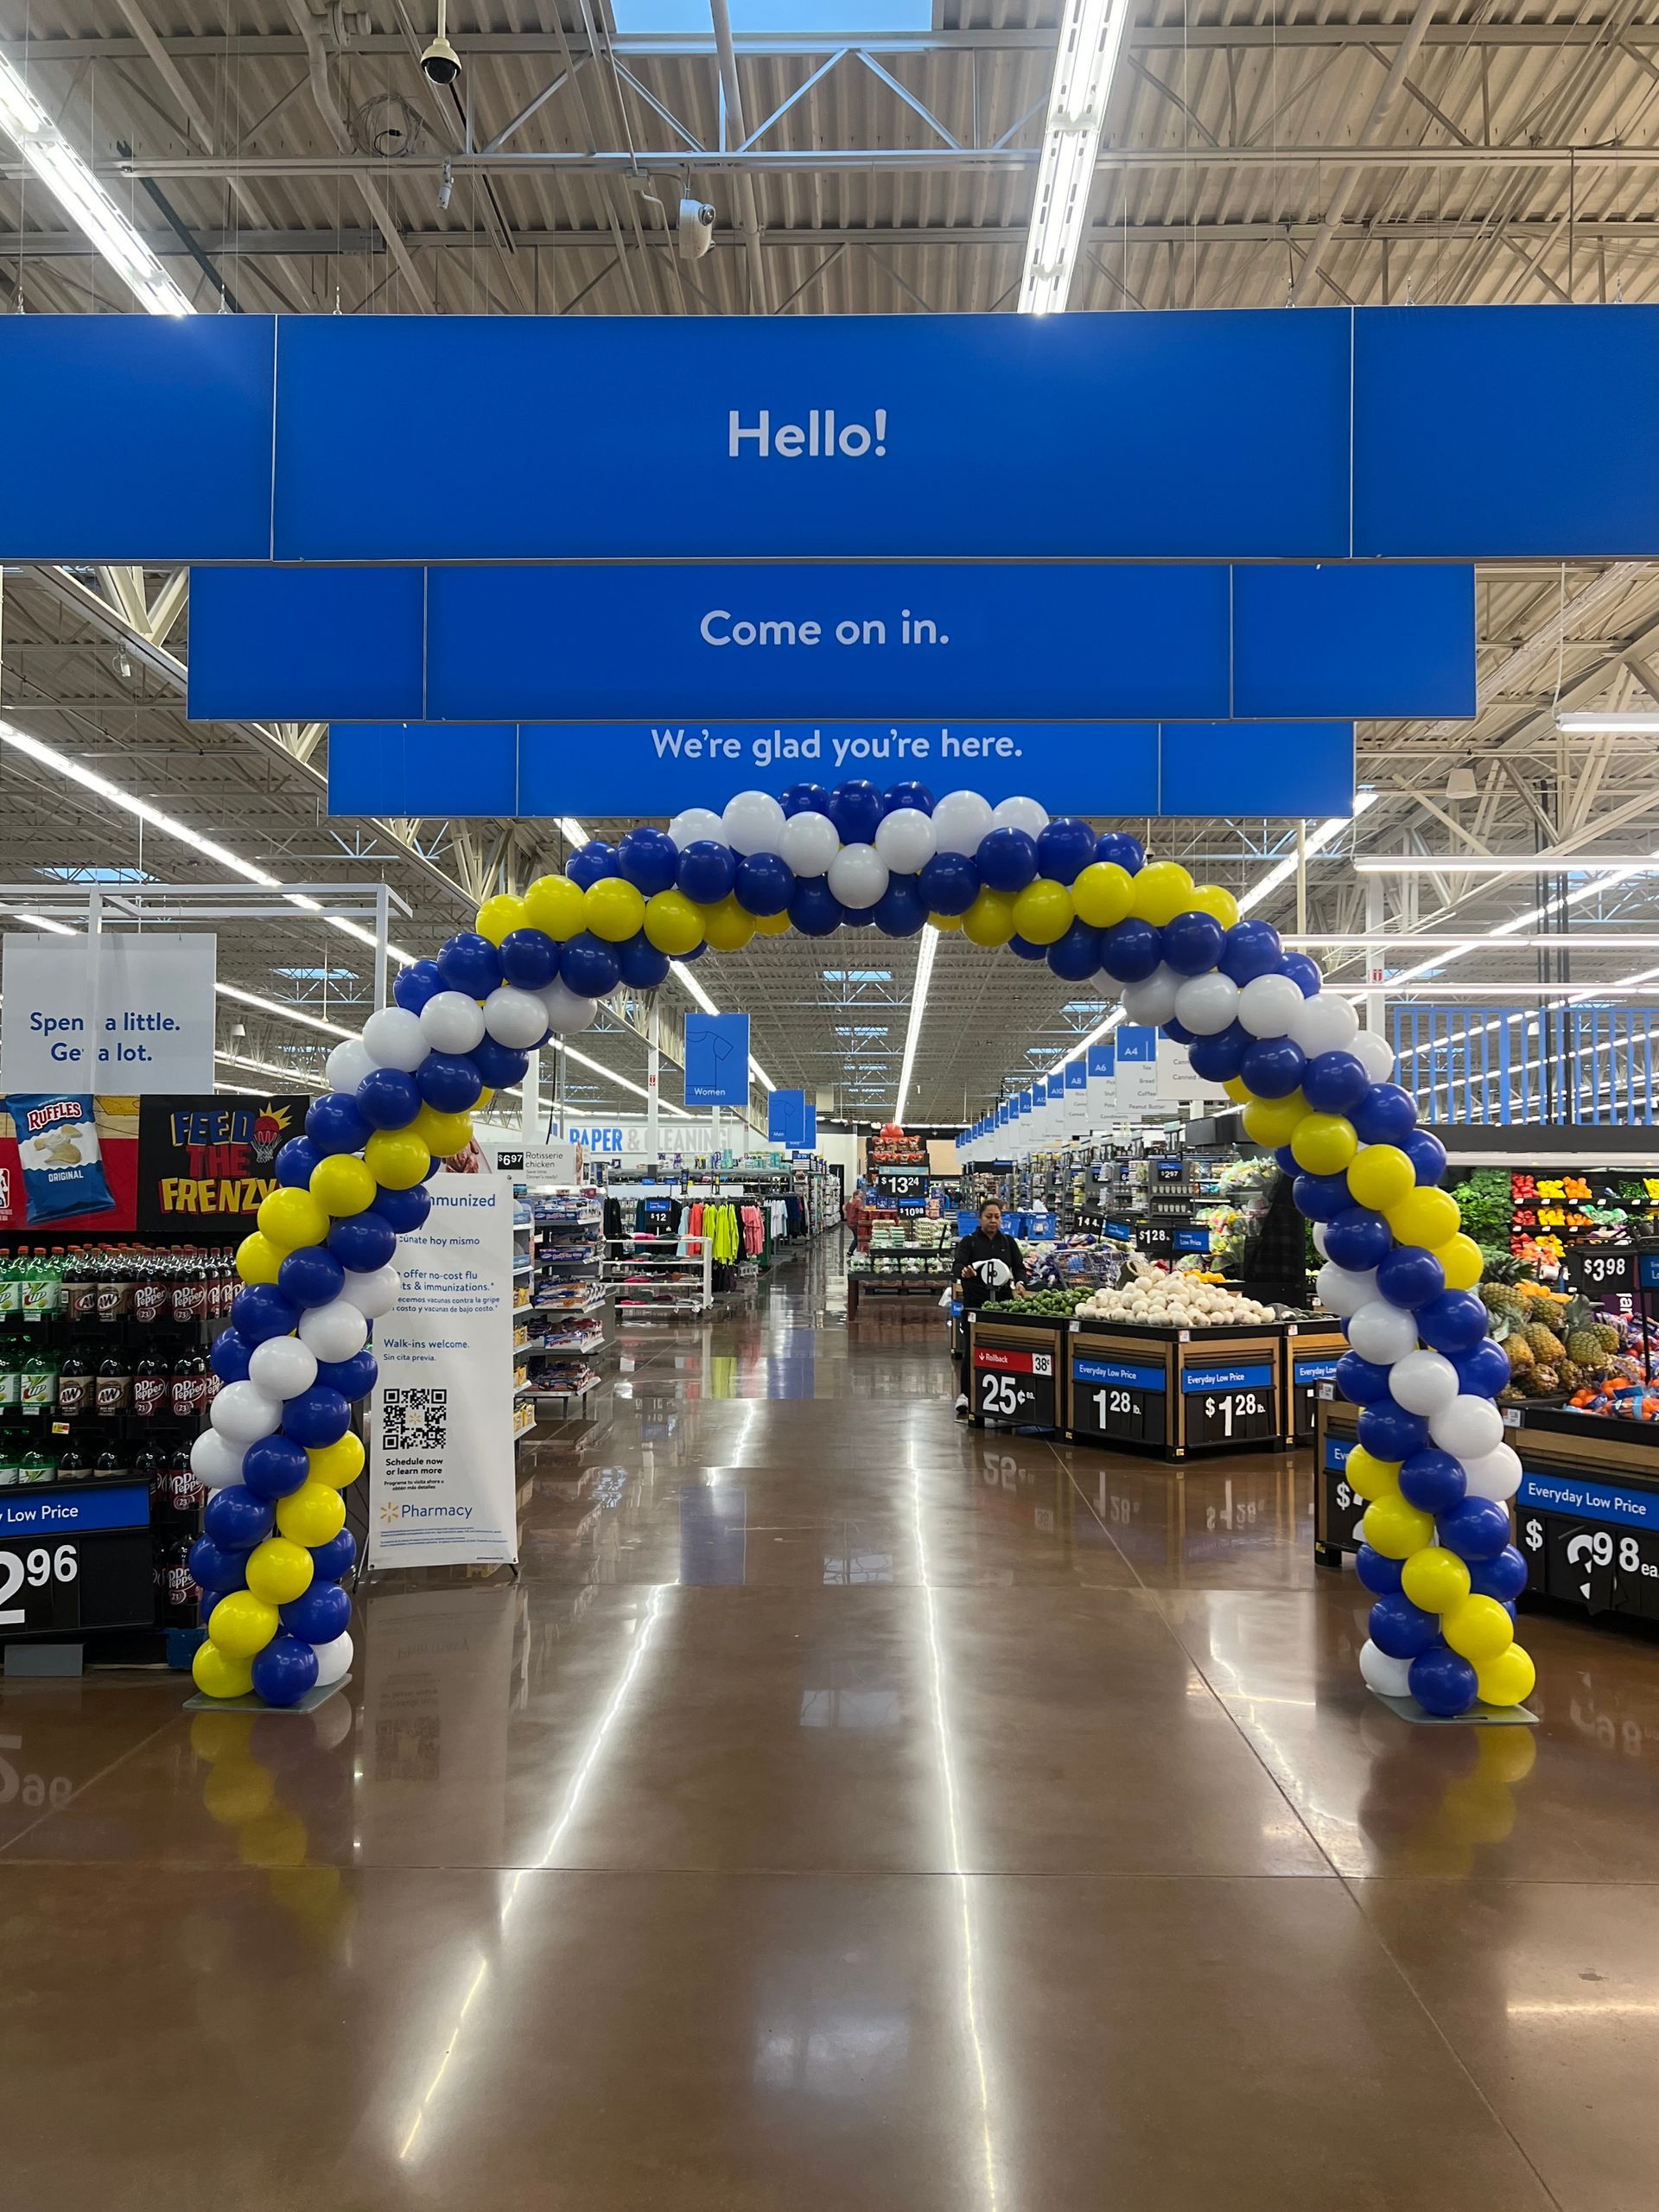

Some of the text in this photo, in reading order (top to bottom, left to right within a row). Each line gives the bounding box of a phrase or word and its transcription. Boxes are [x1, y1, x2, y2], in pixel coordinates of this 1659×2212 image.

[728, 409, 887, 457] Hello!
[700, 609, 950, 646] Come on in.
[651, 728, 1023, 766] We're glad you're here.
[30, 1012, 181, 1036] Spen a little.
[50, 1042, 152, 1062] Ge a lot.
[1124, 1047, 1138, 1056] A4
[28, 1102, 83, 1131] RUFFLES
[170, 1110, 256, 1147] FEED
[569, 1128, 623, 1152] PAPER
[627, 1128, 639, 1151] &
[185, 1145, 251, 1179] THE
[525, 1151, 563, 1160] Rotisserie
[48, 1170, 84, 1183] ORIGINAL
[429, 1193, 496, 1207] munized
[651, 1213, 666, 1222] $12
[429, 1236, 447, 1248] hoy
[449, 1236, 480, 1245] mismo
[403, 1269, 428, 1278] offer
[429, 1271, 462, 1280] no-cost
[465, 1271, 478, 1280] flu
[1584, 1257, 1626, 1281] $398
[414, 1281, 422, 1291] &
[135, 1288, 166, 1307] Pepper
[173, 1288, 205, 1307] Pepper
[384, 1339, 470, 1349] Walk-ins welcome.
[986, 1353, 1008, 1363] Rollback
[1078, 1364, 1137, 1380] Everyday Low Price
[1187, 1372, 1244, 1384] Everyday Low Price
[1299, 1367, 1325, 1377] Everyday
[134, 1382, 163, 1401] Pepper
[173, 1382, 205, 1401] Pepper
[385, 1458, 424, 1466] Schedule
[1528, 1482, 1647, 1516] Everyday Low Price
[7, 1508, 36, 1522] Low
[41, 1504, 79, 1520] Price
[401, 1503, 474, 1520] Pharmacy
